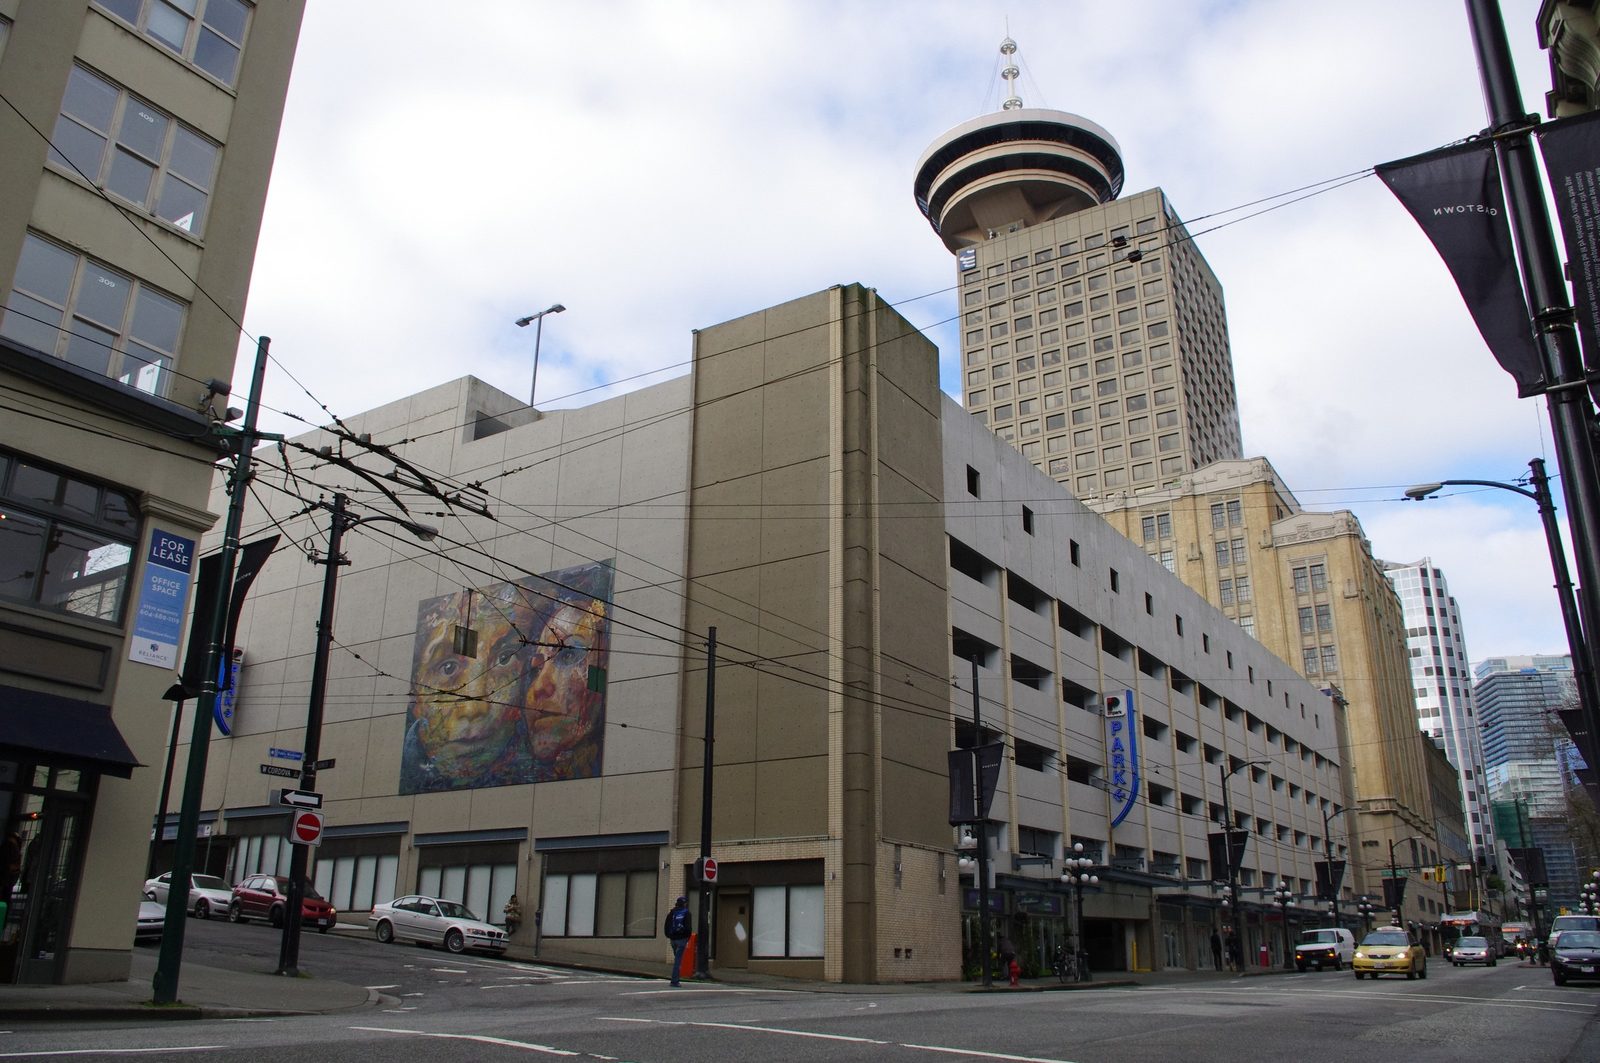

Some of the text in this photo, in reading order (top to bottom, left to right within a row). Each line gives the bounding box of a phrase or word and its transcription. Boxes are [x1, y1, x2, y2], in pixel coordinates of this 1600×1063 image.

[138, 111, 154, 123] 409
[98, 276, 116, 288] 309
[160, 538, 185, 553] FOR
[152, 546, 189, 566] LEASE
[151, 576, 181, 590] OFFICE
[152, 584, 177, 597] SPACE
[1111, 720, 1126, 785] PARK
[267, 766, 291, 776] CORDOVA
